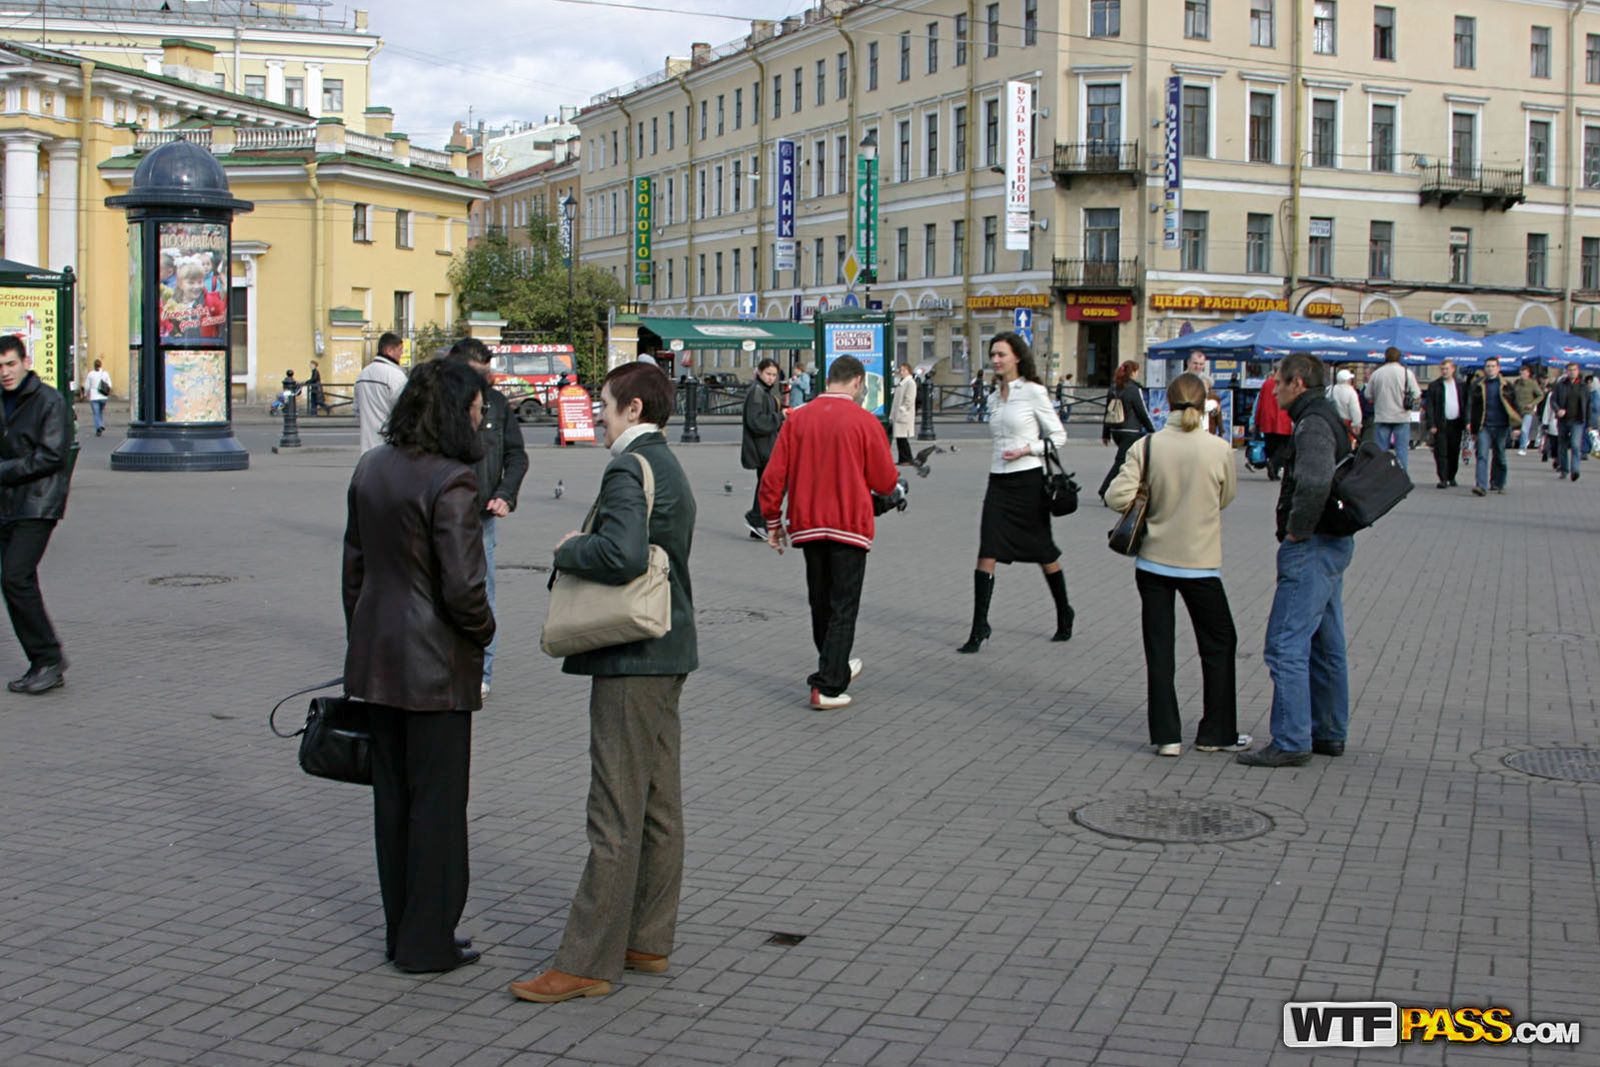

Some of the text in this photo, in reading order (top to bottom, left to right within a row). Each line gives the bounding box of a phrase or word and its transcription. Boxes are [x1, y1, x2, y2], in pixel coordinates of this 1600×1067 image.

[1016, 86, 1025, 123] БУДЬ
[1016, 128, 1026, 203] КРАСИВОЙ
[782, 160, 792, 236] БАНК
[638, 179, 649, 258] ЗОЛОТО
[967, 295, 991, 308] ЦЕНТР
[1082, 308, 1119, 317] ОБУВЬ
[1154, 296, 1288, 311] ЦЕНТР РАСПРОДАЖ
[1308, 303, 1344, 315] ОБУВЬ
[44, 309, 54, 374] ЦИФРОВАЯ
[836, 338, 871, 347] ОБУВЬ
